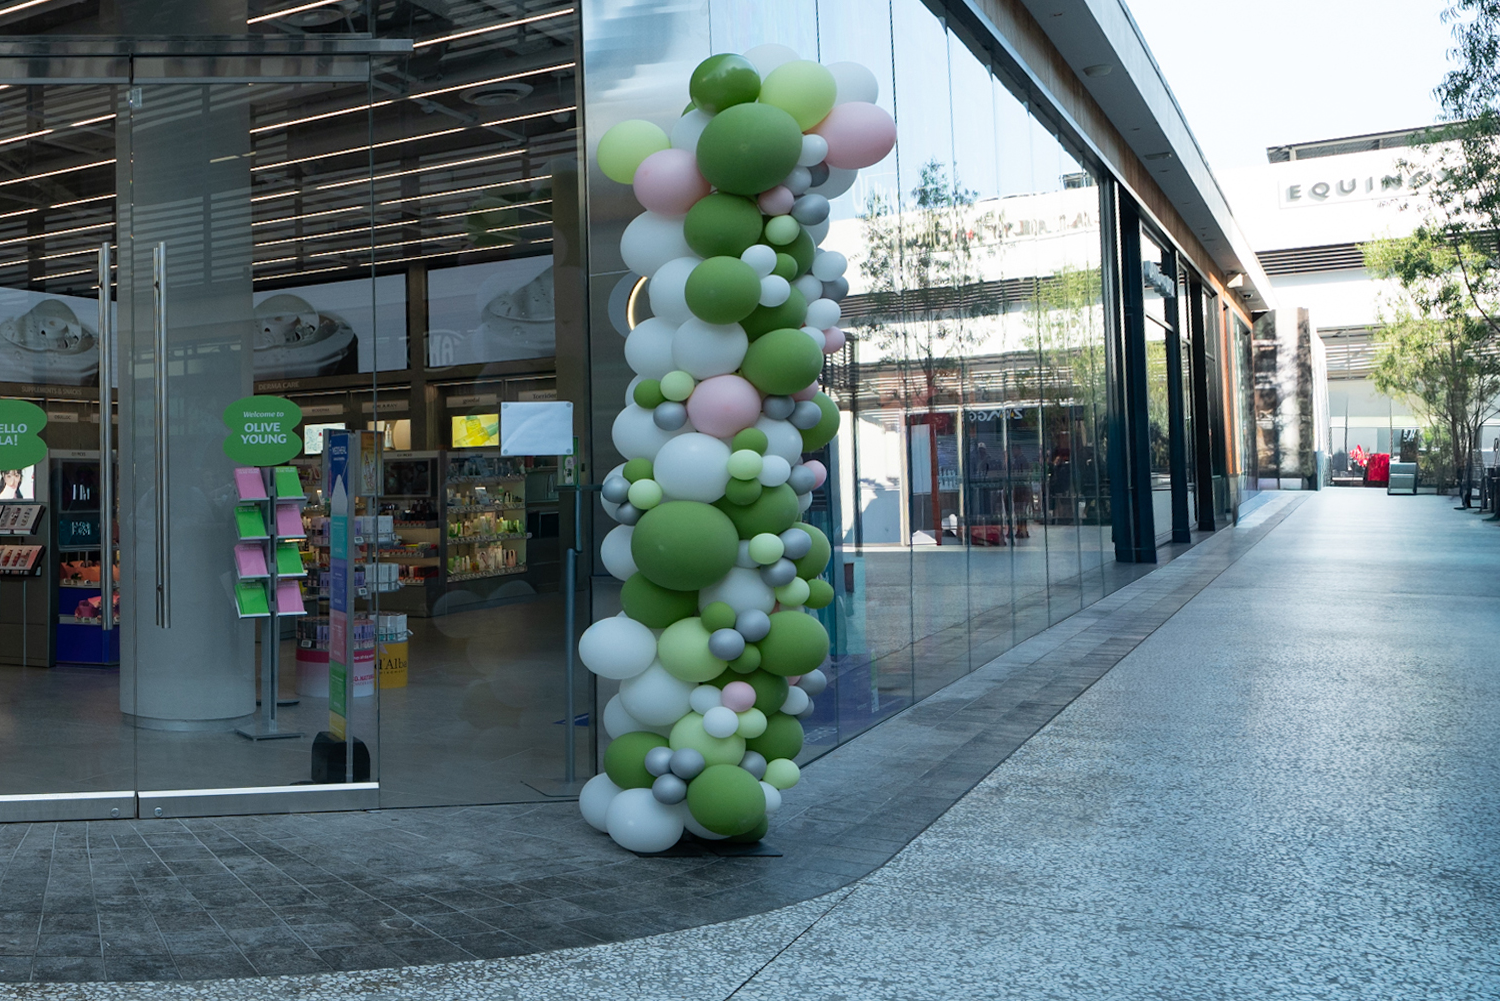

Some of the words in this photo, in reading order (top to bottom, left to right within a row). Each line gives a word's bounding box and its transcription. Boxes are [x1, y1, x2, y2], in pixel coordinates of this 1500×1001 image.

[243, 410, 276, 418] Welcome
[244, 422, 281, 433] OLIVE
[240, 433, 287, 445] YOUNG
